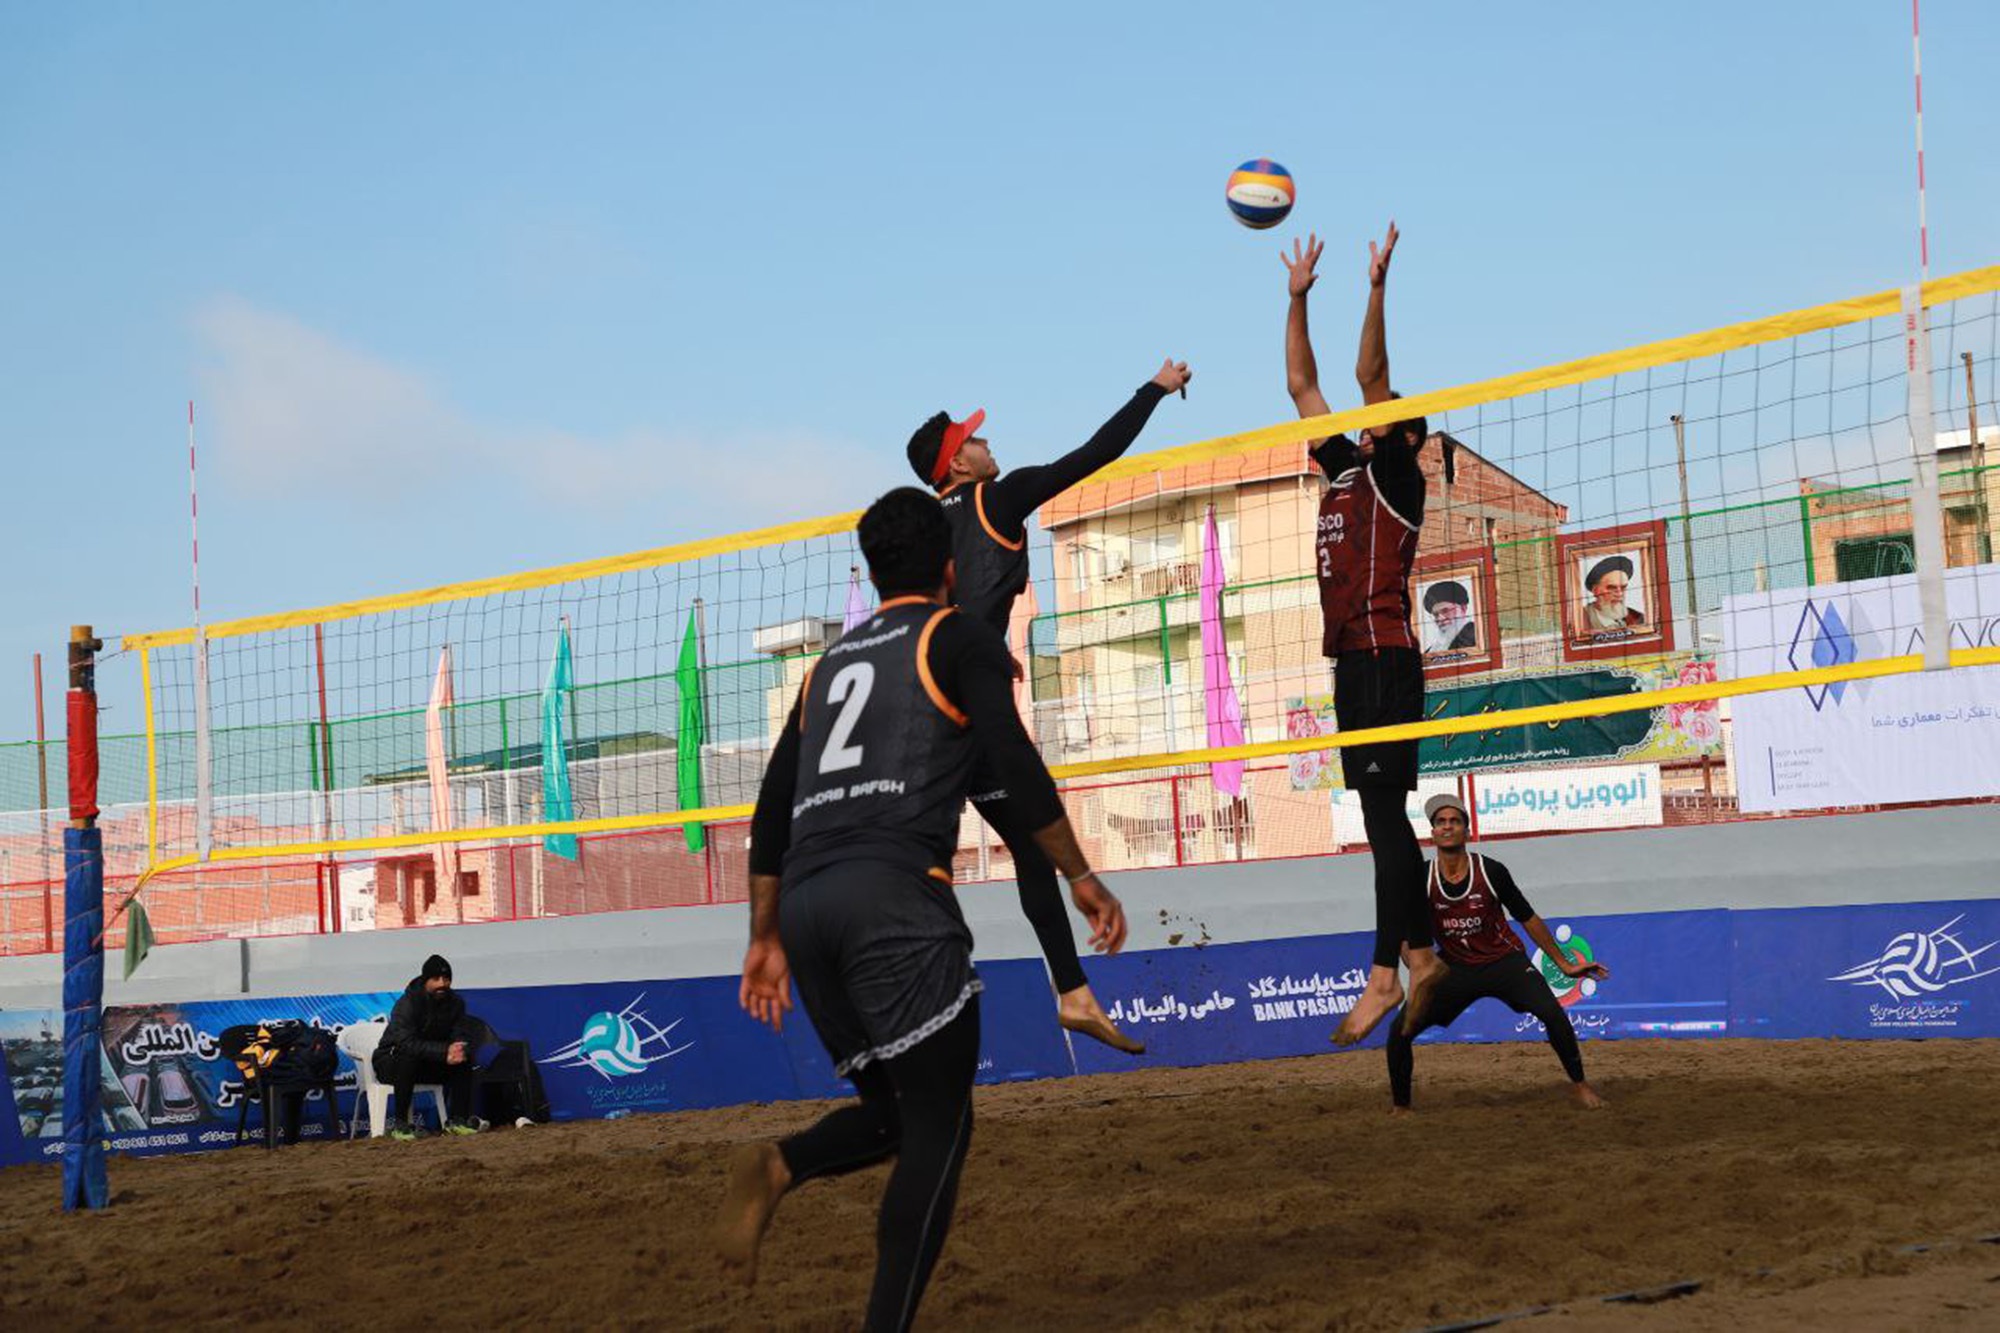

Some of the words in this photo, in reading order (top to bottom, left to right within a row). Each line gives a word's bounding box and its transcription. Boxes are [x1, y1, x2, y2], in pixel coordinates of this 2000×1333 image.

[1319, 548, 1332, 577] 2
[819, 661, 875, 775] 2
[1898, 711, 1942, 728] معماری
[1476, 784, 1560, 816] پروفیل
[1565, 771, 1647, 810] آلووین
[1126, 995, 1188, 1023] والیبال
[1190, 990, 1236, 1019] حامی
[1252, 1000, 1298, 1021] BANK
[122, 1022, 198, 1066] المللی
